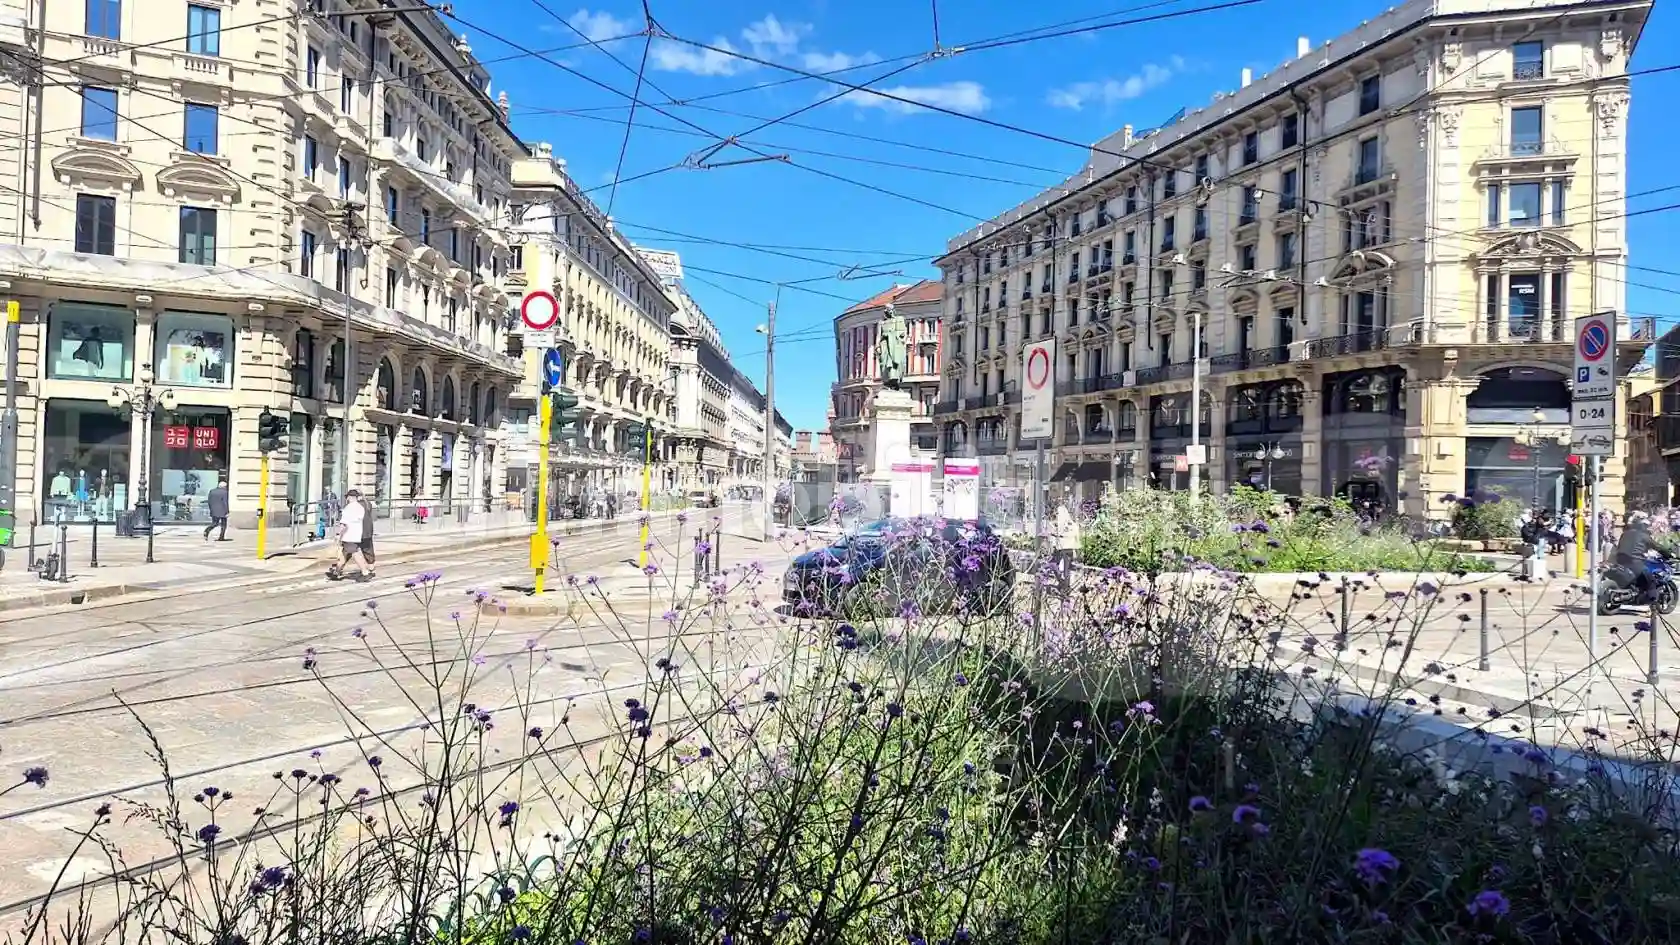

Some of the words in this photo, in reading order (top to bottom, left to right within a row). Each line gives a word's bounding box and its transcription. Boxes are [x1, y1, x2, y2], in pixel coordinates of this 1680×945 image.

[1580, 408, 1605, 419] 0-24
[196, 429, 215, 438] UNI
[196, 438, 216, 448] QLO
